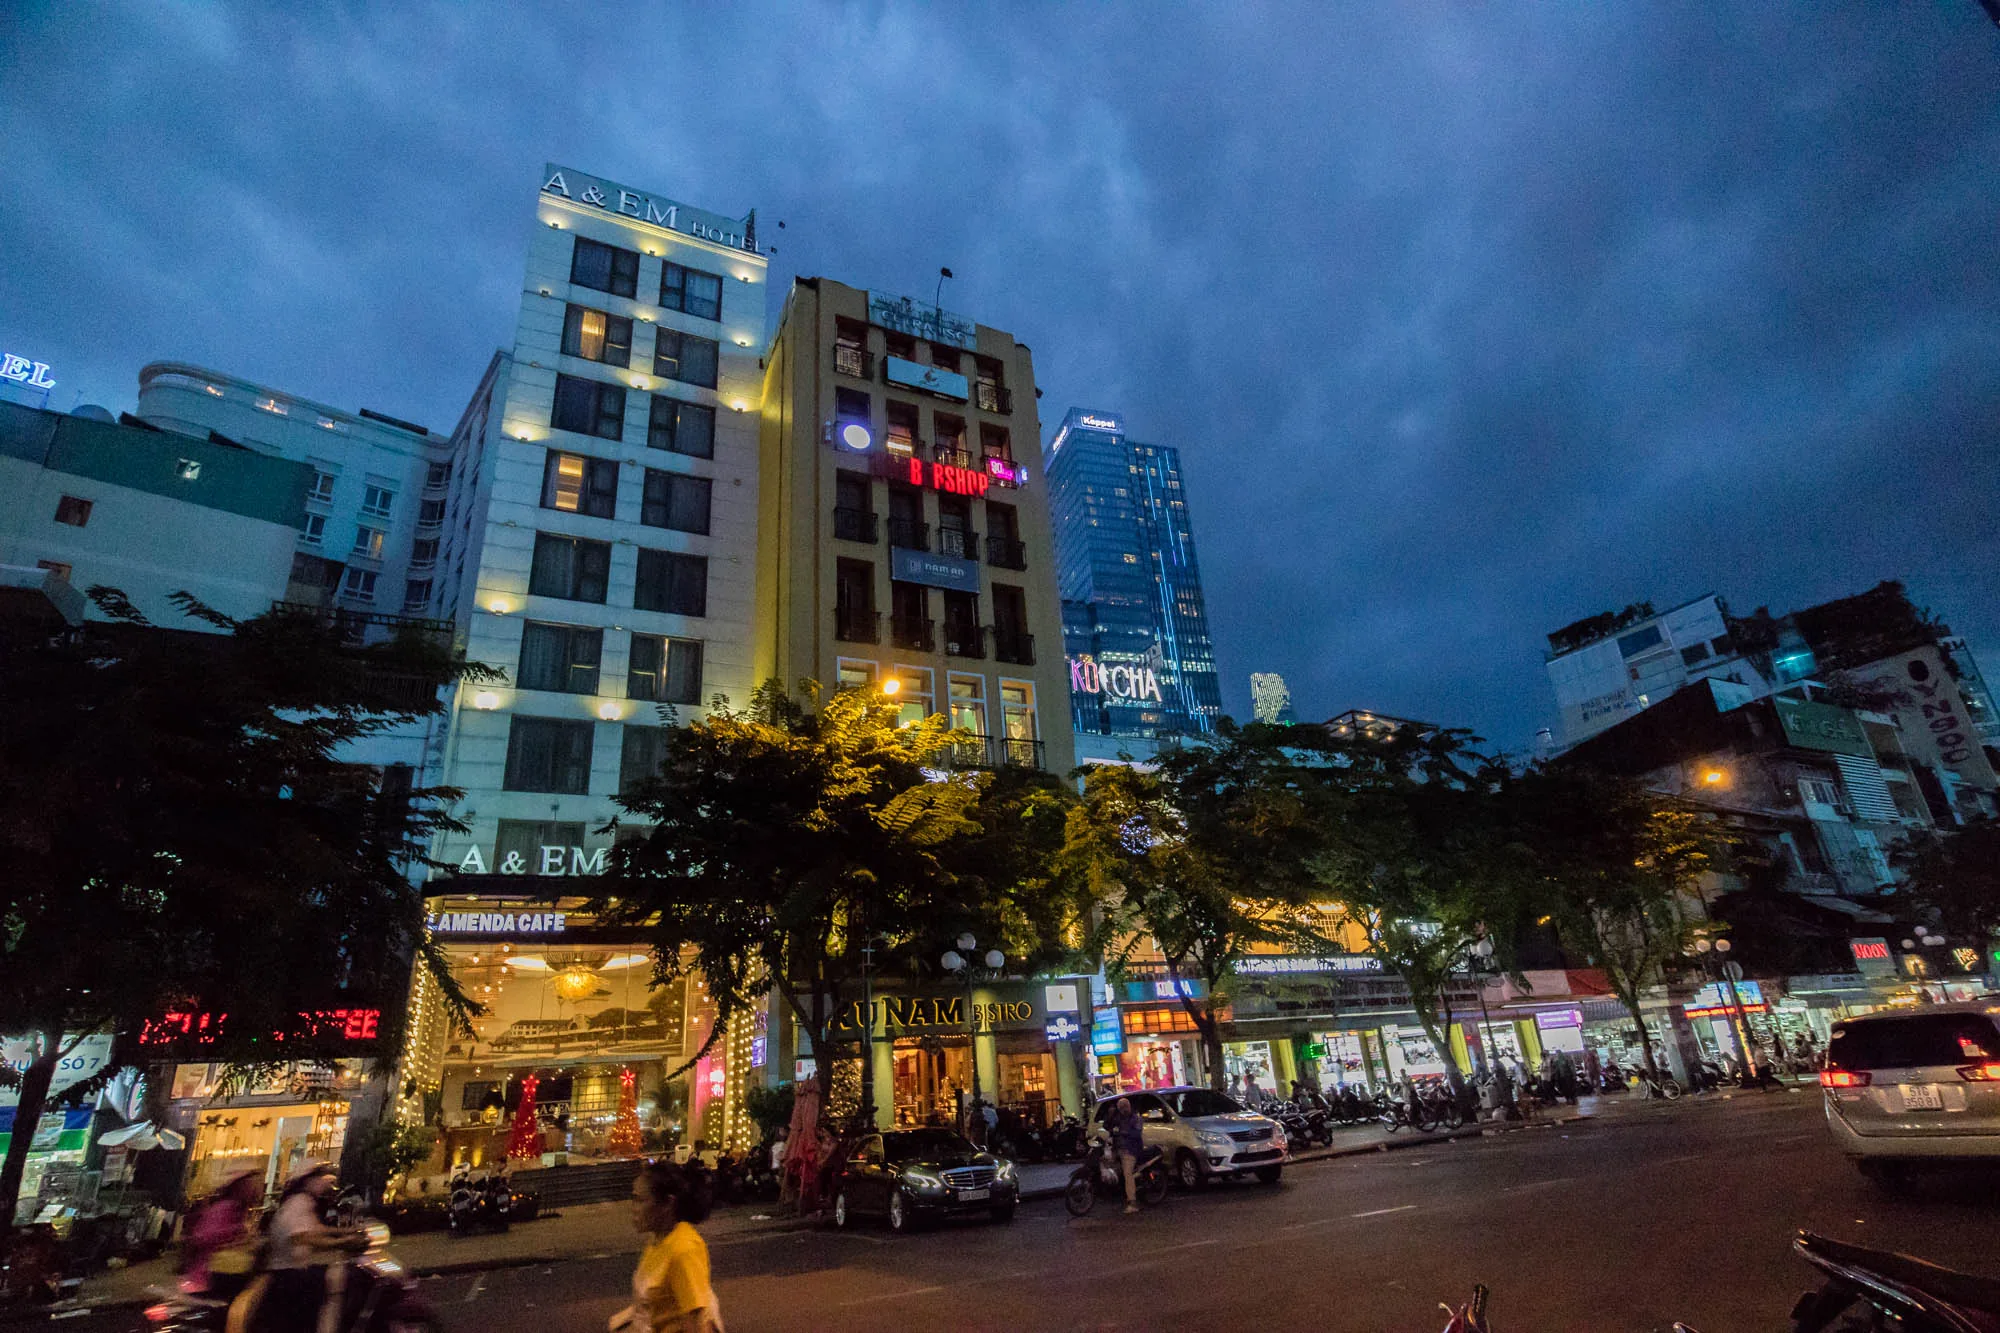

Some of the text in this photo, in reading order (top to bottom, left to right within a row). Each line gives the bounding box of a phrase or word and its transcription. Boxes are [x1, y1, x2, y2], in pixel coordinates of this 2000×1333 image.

[541, 172, 572, 200] A
[581, 187, 606, 208] &
[616, 190, 680, 231] EM
[1083, 416, 1116, 429] Keppel
[459, 843, 608, 877] A & EM
[517, 912, 566, 932] CAFE
[972, 1001, 1032, 1023] BISTRO
[89, 1058, 100, 1070] 7
